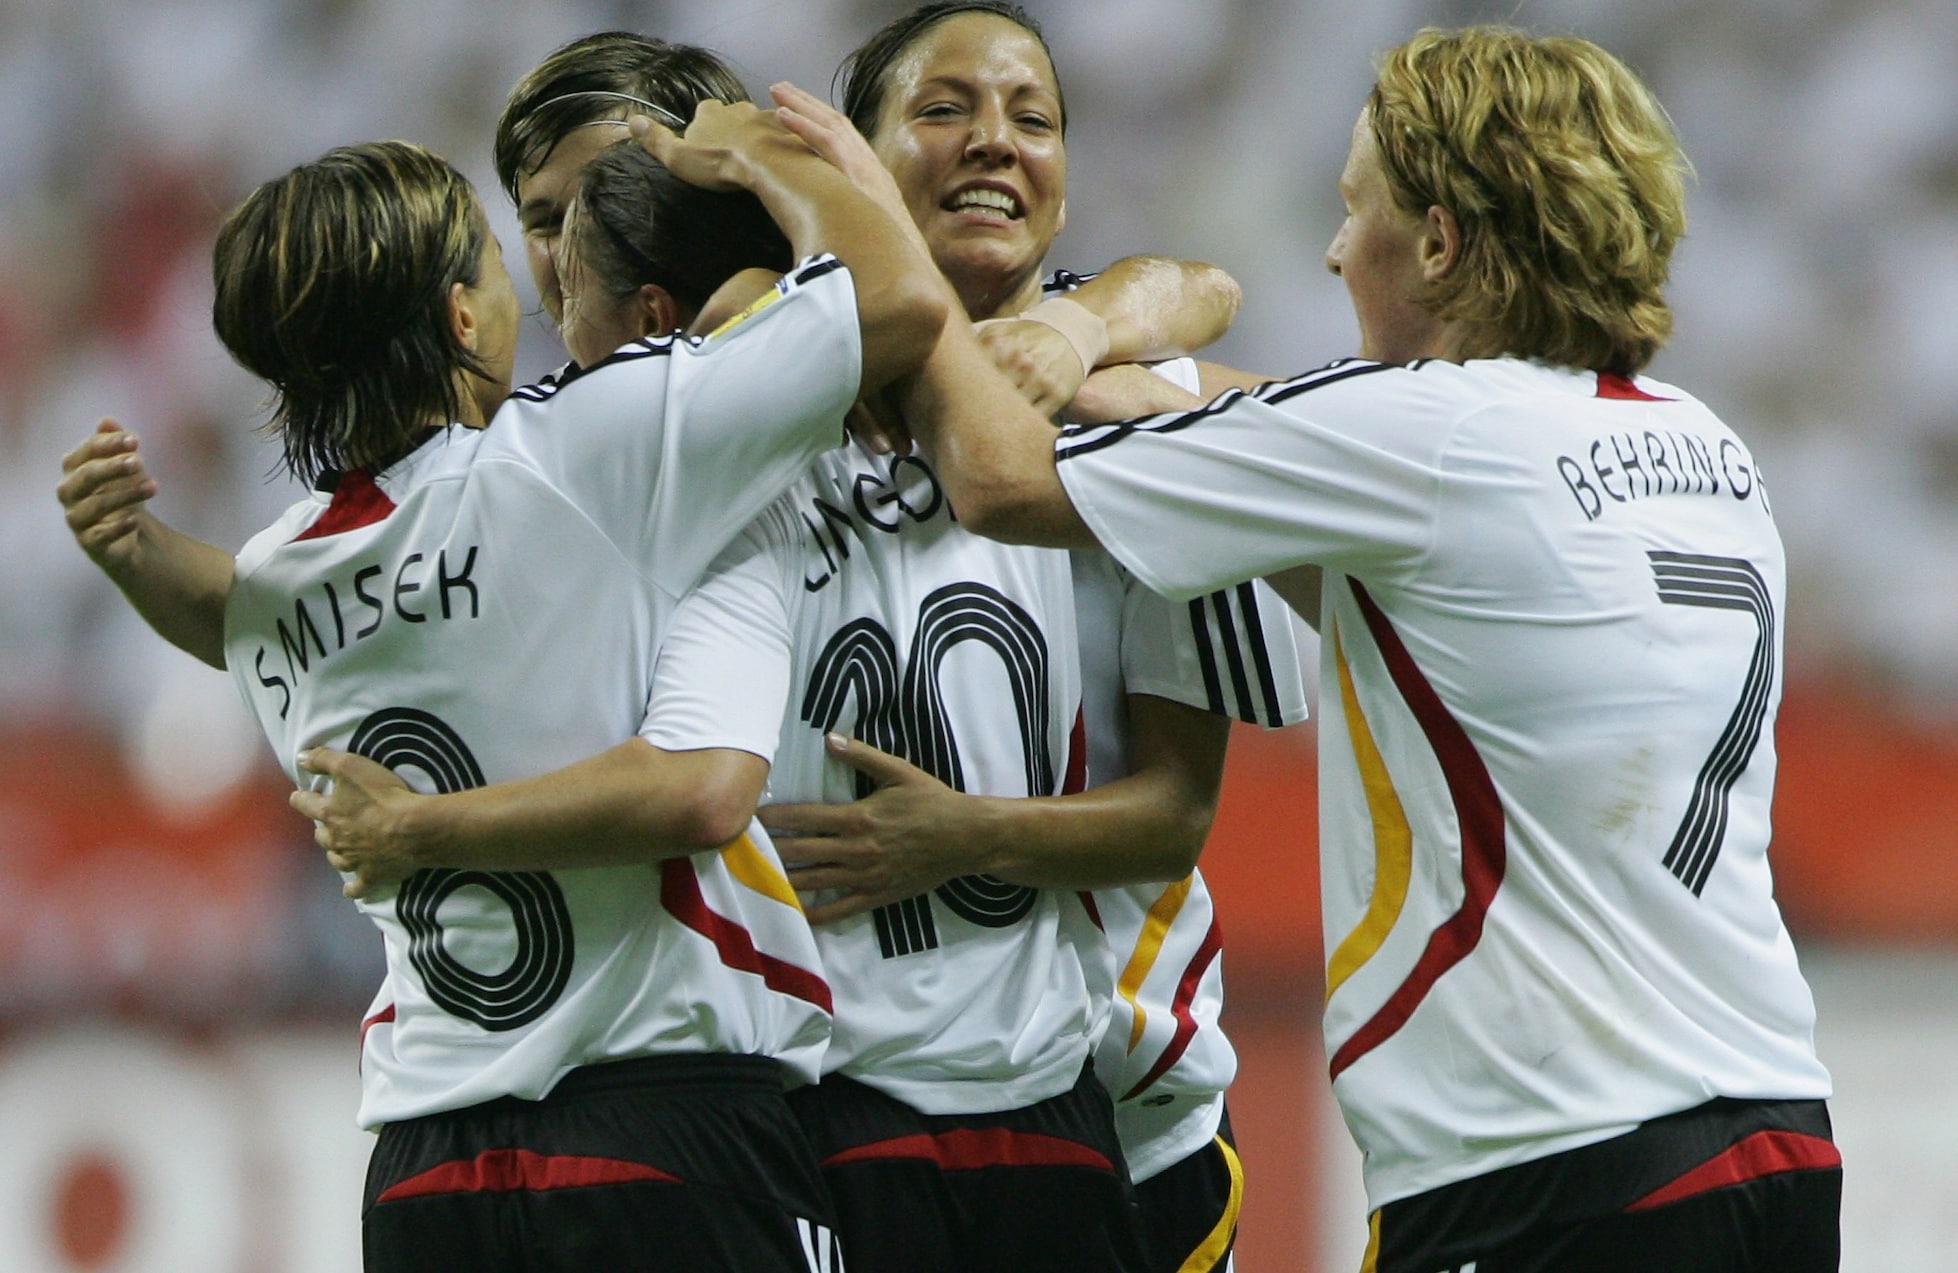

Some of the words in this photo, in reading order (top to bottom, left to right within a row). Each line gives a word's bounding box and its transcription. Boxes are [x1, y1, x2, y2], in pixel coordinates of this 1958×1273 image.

[255, 546, 479, 720] SMISEK
[800, 581, 1054, 960] 10
[1645, 550, 1775, 899] 7
[347, 706, 575, 1032] 8
